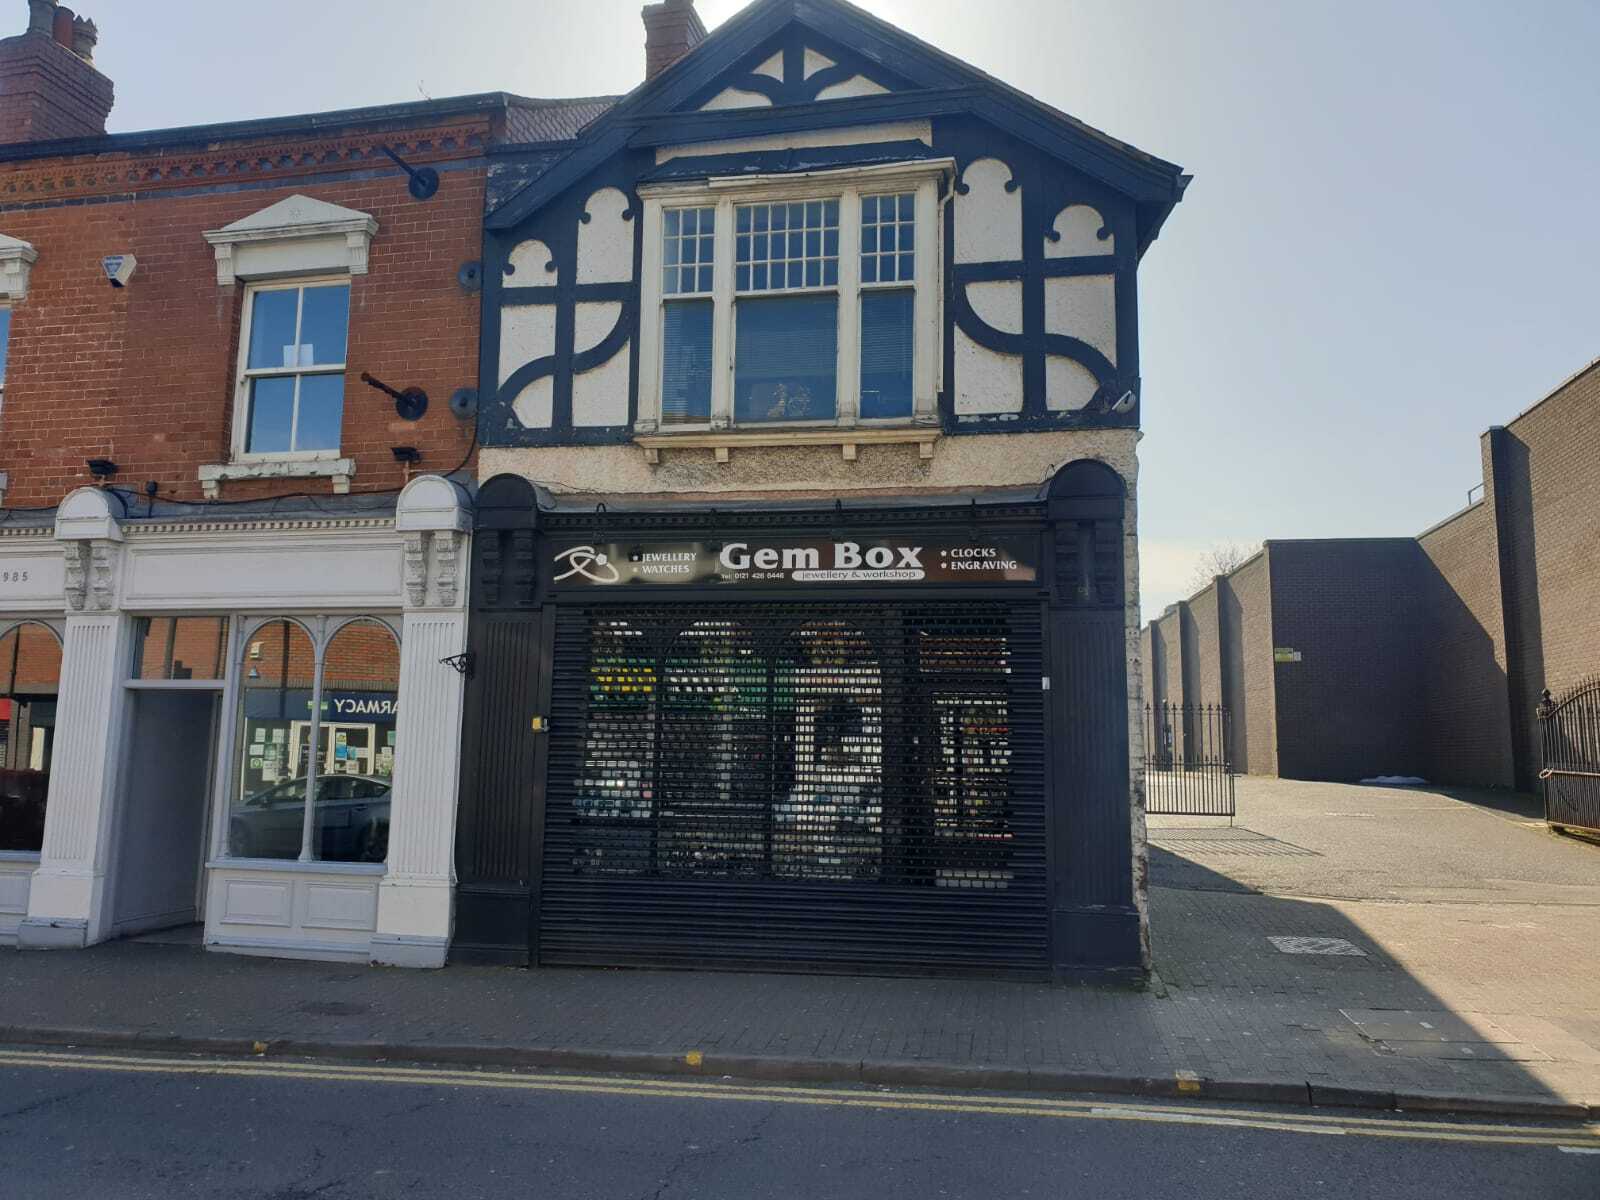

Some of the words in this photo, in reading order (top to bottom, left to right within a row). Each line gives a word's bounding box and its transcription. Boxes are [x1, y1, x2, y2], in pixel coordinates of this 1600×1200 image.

[642, 552, 697, 563] JEWELLERY
[720, 543, 819, 570] Gem
[834, 542, 923, 569] Box
[951, 548, 996, 558] CLOCKS
[641, 564, 690, 574] WATCHES
[951, 561, 1017, 570] ENGRAVING
[802, 570, 848, 580] jewellery
[864, 569, 916, 580] workshop
